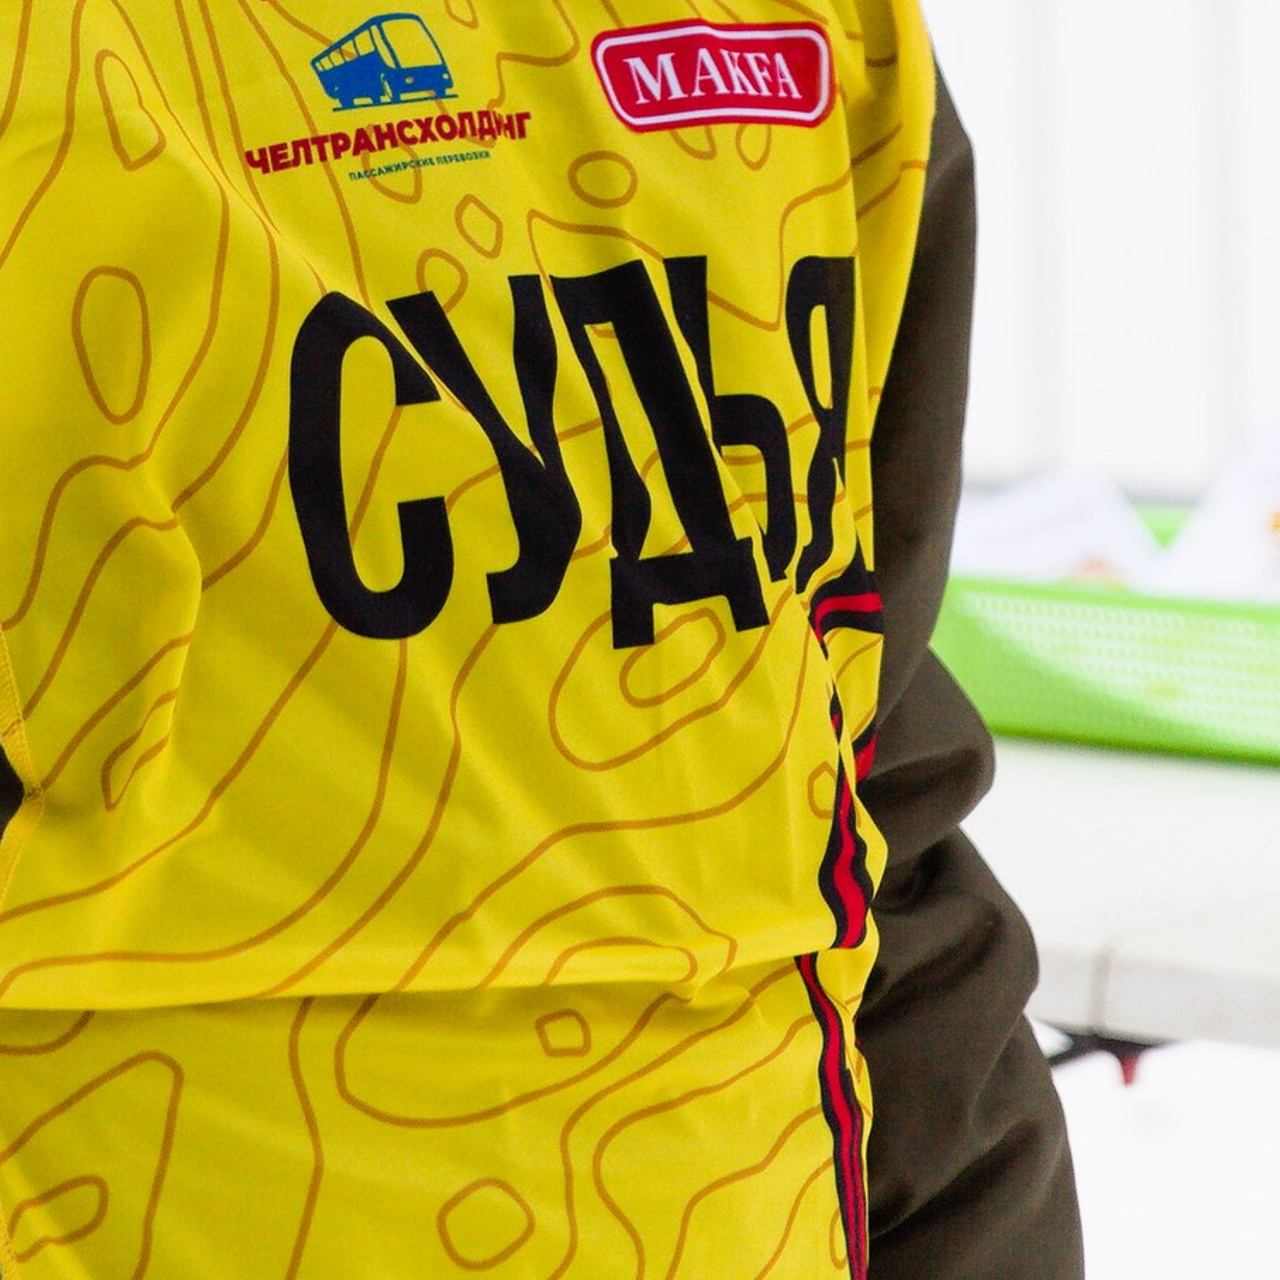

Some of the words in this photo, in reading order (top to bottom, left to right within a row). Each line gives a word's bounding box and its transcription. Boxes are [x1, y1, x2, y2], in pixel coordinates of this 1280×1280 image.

[623, 46, 804, 105] MAKFA
[349, 158, 436, 181] ПАССАЖИРСКИЕ
[287, 254, 856, 651] СУДЬЯ
